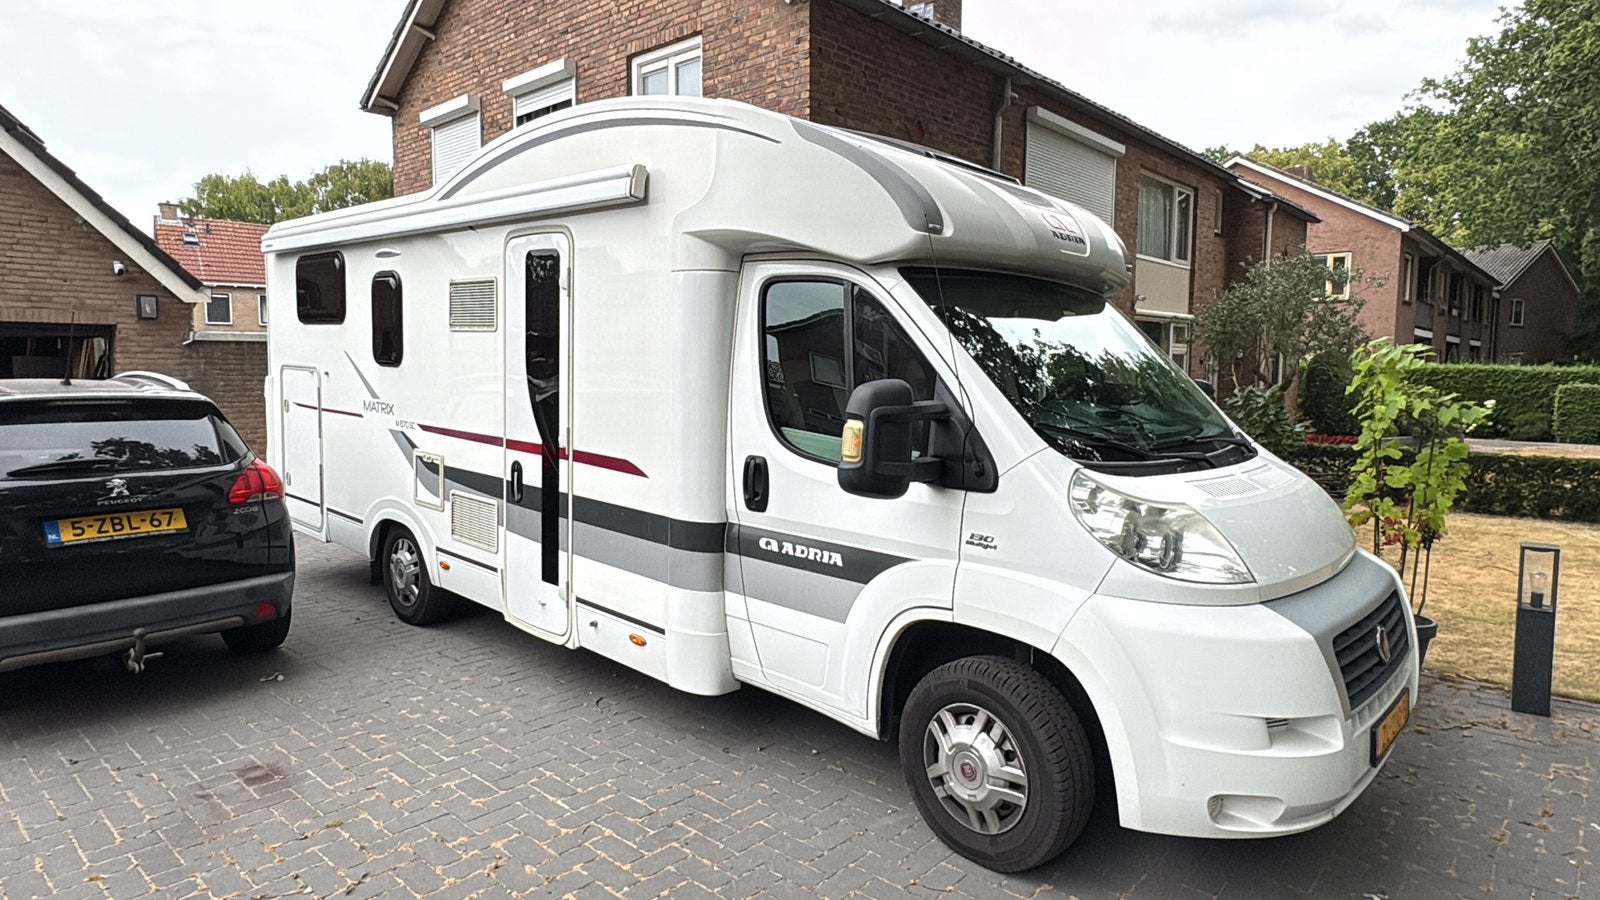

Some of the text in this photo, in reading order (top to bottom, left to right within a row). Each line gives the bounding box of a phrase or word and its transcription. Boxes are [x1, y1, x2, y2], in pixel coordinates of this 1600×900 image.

[363, 400, 395, 415] MATRIX
[70, 511, 174, 537] 5-ZBL-67
[969, 532, 995, 543] 130
[781, 541, 843, 567] ADRIA
